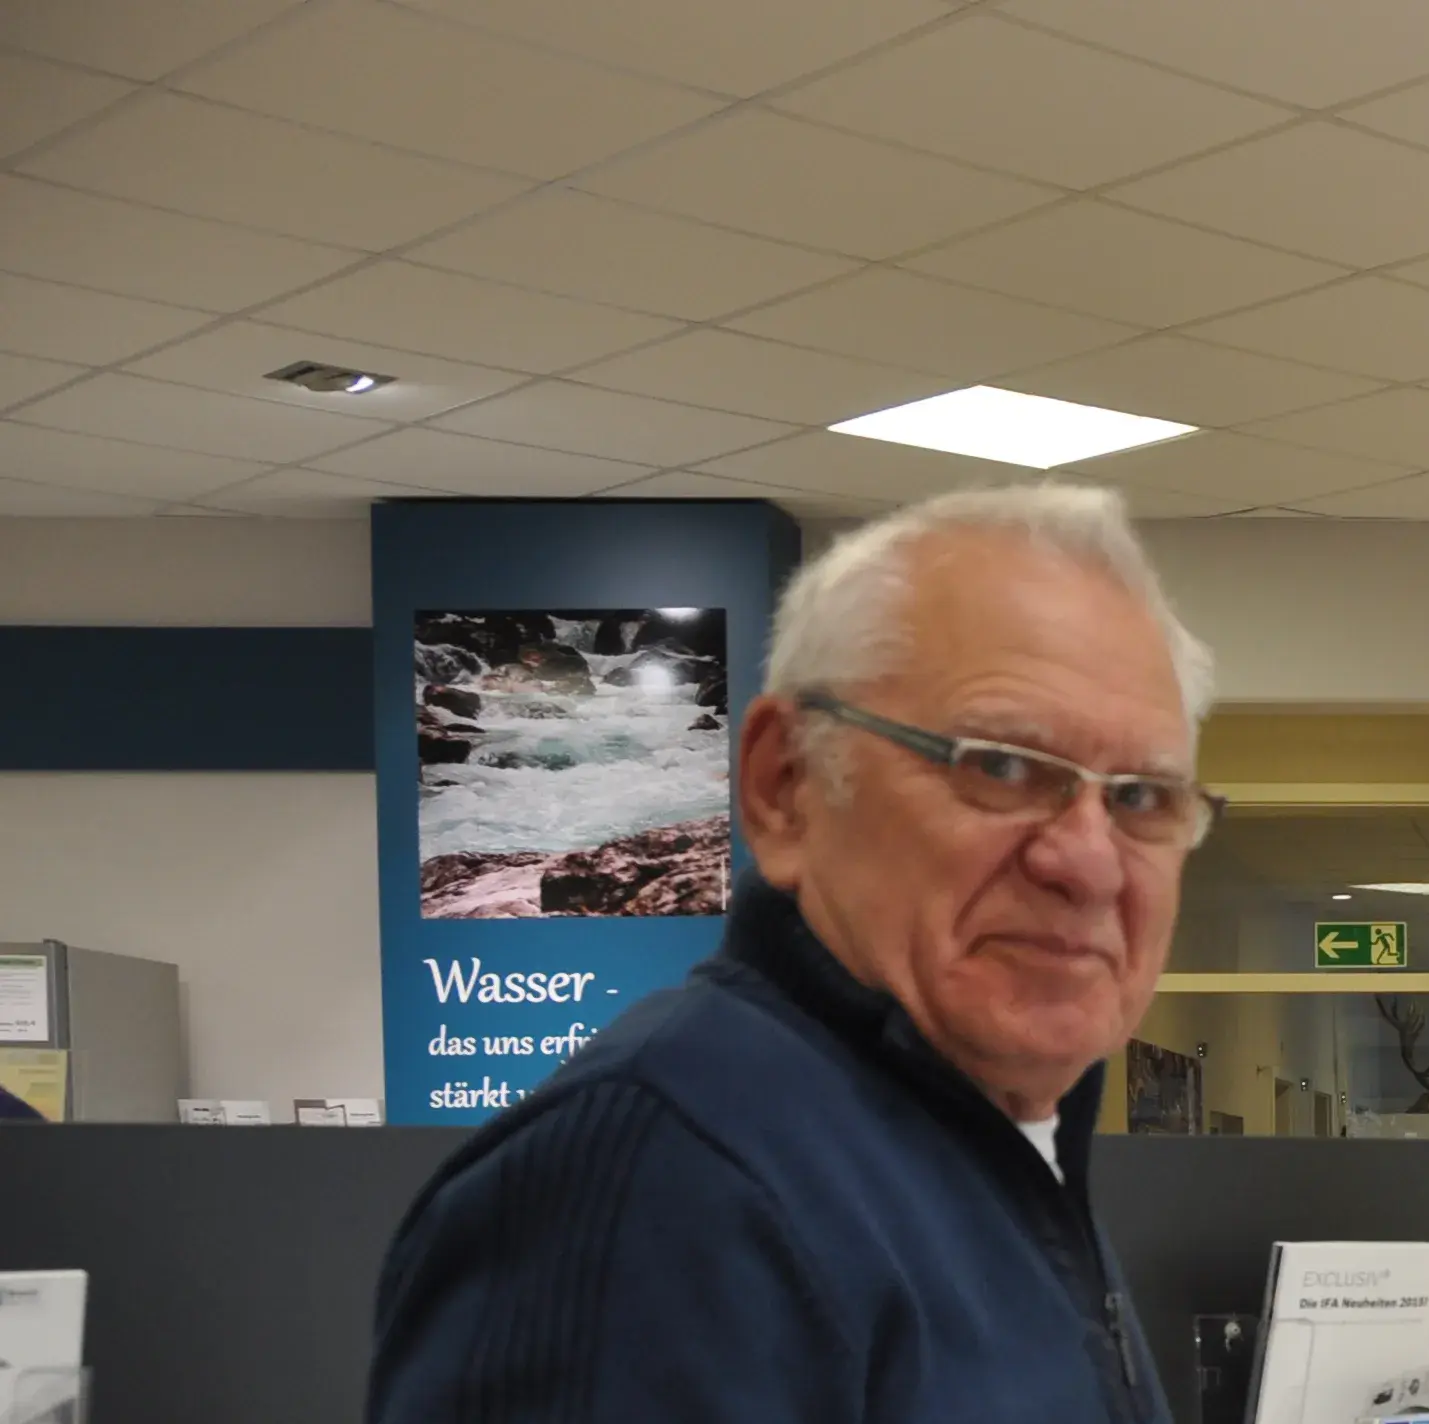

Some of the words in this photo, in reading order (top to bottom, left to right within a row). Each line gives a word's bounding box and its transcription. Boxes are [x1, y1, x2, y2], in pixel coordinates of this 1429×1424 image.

[422, 957, 596, 1004] Wasser
[427, 1023, 478, 1057] das
[482, 1035, 535, 1056] uns
[429, 1075, 511, 1109] stärkt
